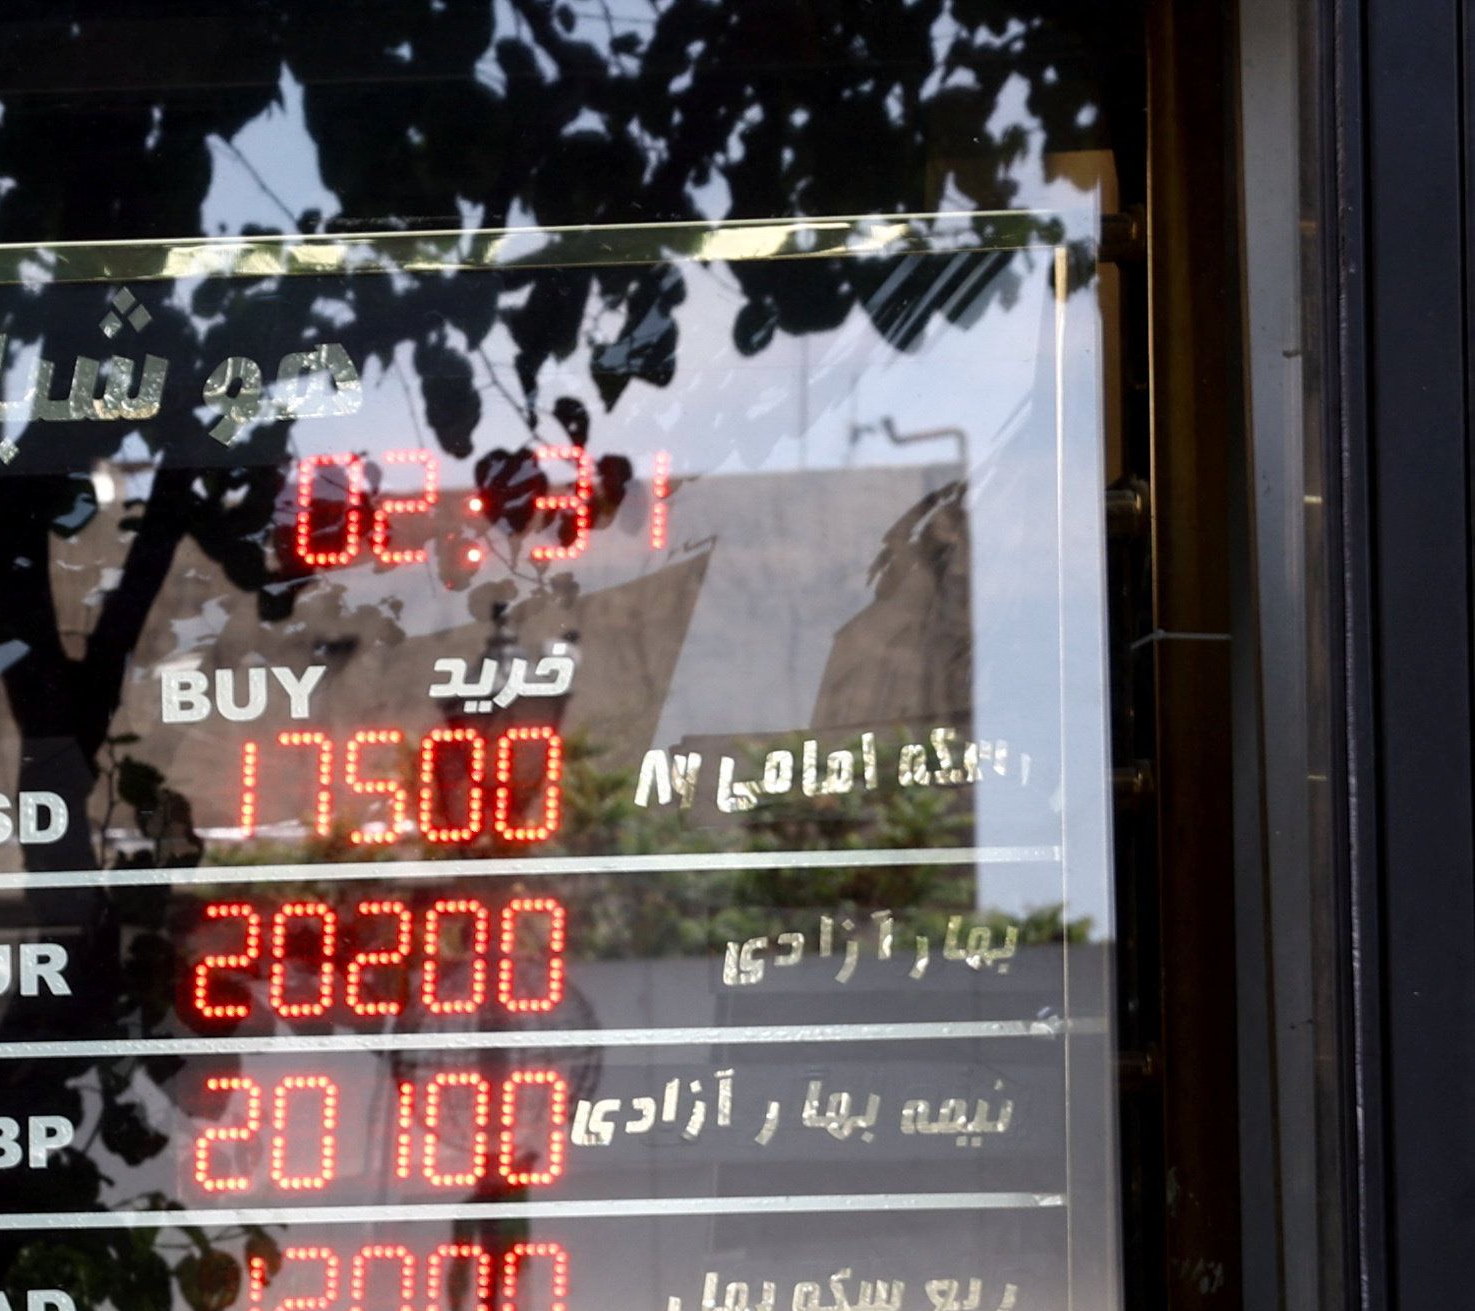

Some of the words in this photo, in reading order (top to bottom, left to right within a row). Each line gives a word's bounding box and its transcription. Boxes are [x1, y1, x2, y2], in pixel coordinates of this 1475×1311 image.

[161, 664, 326, 724] BUY
[430, 642, 573, 714] خرید
[236, 724, 564, 846] 17500
[193, 896, 567, 1020] 20200
[193, 1068, 569, 1195] 20100
[570, 1069, 734, 1145] آزادی
[754, 1080, 881, 1145] بهار
